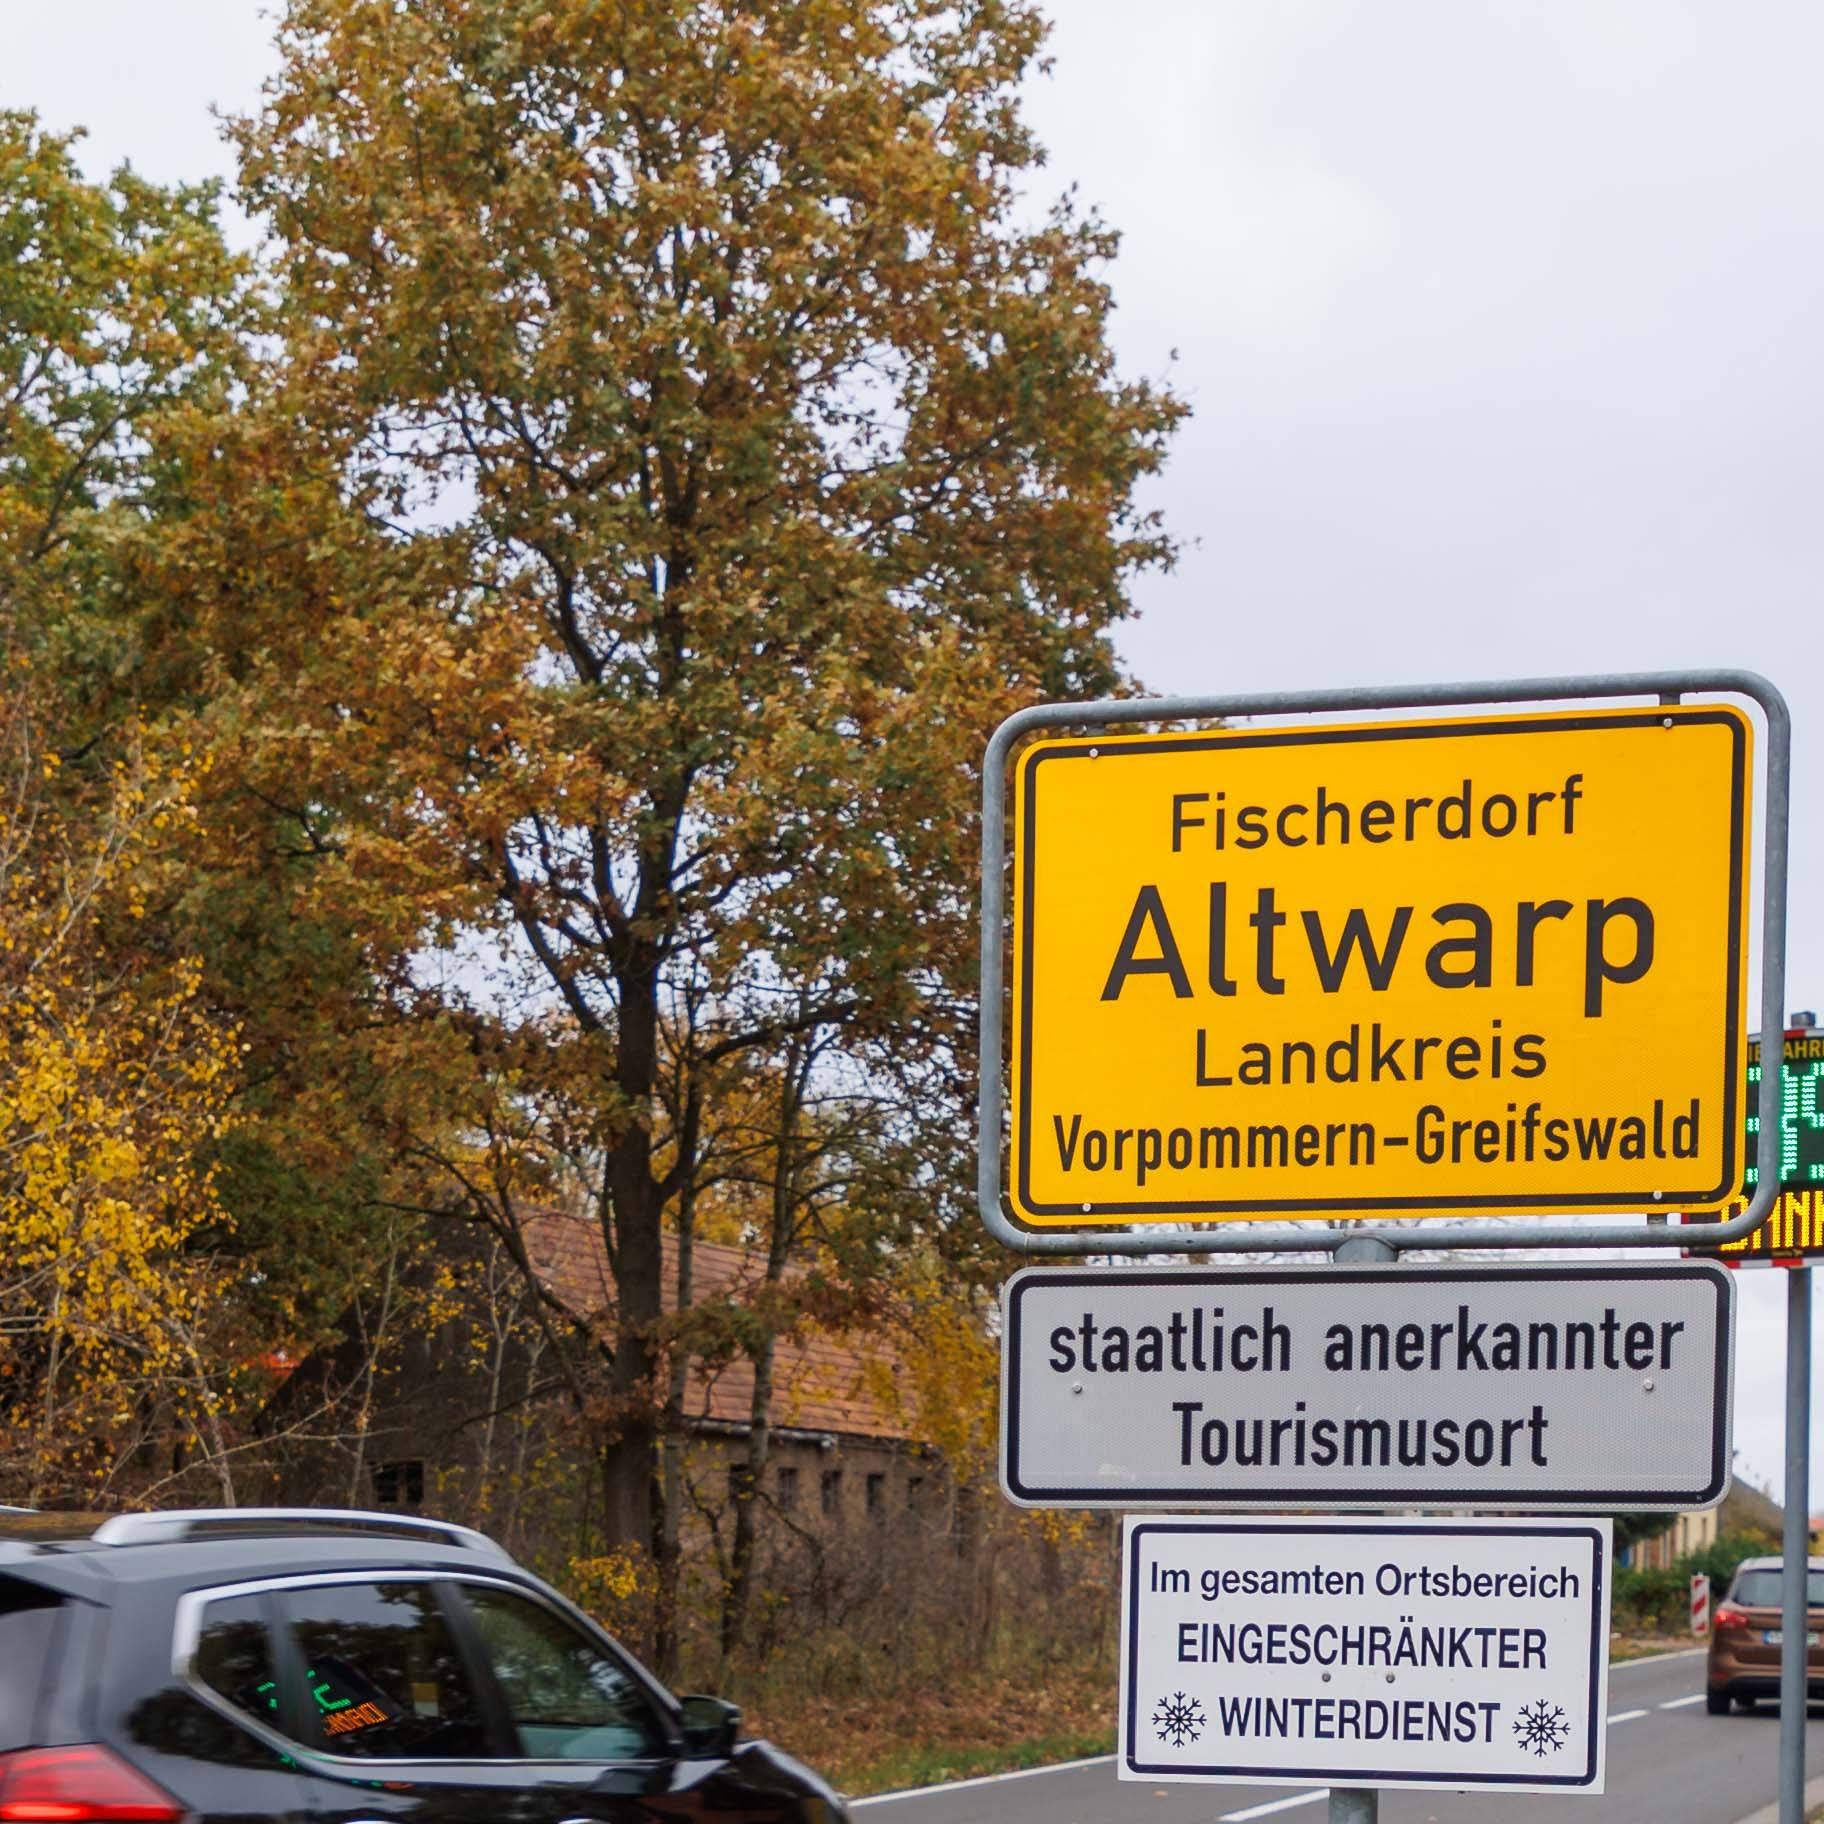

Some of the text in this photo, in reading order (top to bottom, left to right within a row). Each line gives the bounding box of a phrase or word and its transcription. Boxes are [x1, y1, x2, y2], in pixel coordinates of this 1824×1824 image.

[1172, 773, 1584, 853] Fischerdorf
[1101, 881, 1655, 1018] Altwarp
[1195, 1019, 1547, 1087] Landkreis
[1053, 1098, 1701, 1187] Vorpommern-Greifswald
[1049, 1305, 1685, 1374] staatlich anerkannter
[1172, 1401, 1549, 1468] Tourismusort
[1151, 1561, 1579, 1602] Im gesamten Ortsbereich
[1177, 1615, 1547, 1670] EINGESCHRÄNKTER
[1218, 1696, 1501, 1743] WINTERDIENST
